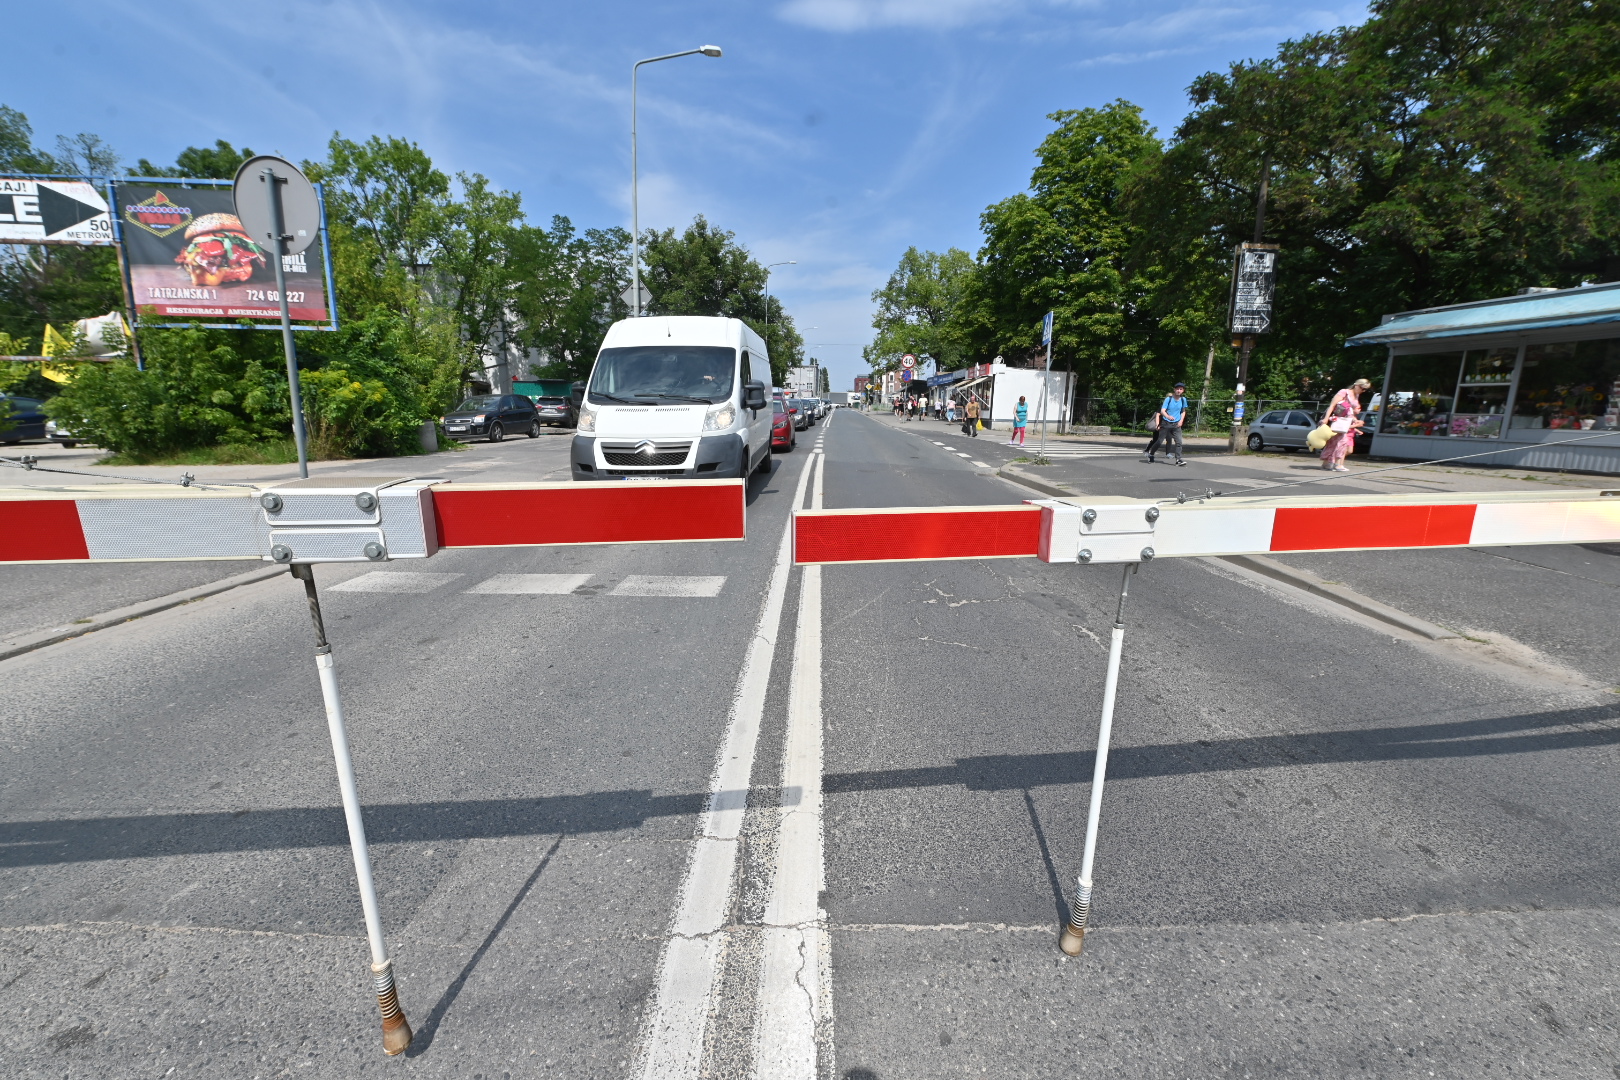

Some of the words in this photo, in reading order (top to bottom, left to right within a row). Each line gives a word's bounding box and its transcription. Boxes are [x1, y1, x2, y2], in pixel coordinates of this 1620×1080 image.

[90, 219, 109, 231] 50
[282, 265, 308, 273] EX-MEX
[212, 289, 217, 300] 1
[246, 290, 265, 301] 724
[266, 290, 280, 302] 60
[286, 291, 305, 303] 227
[166, 307, 225, 315] RESTAURACJA
[227, 308, 291, 317] AMERYKAŃS
